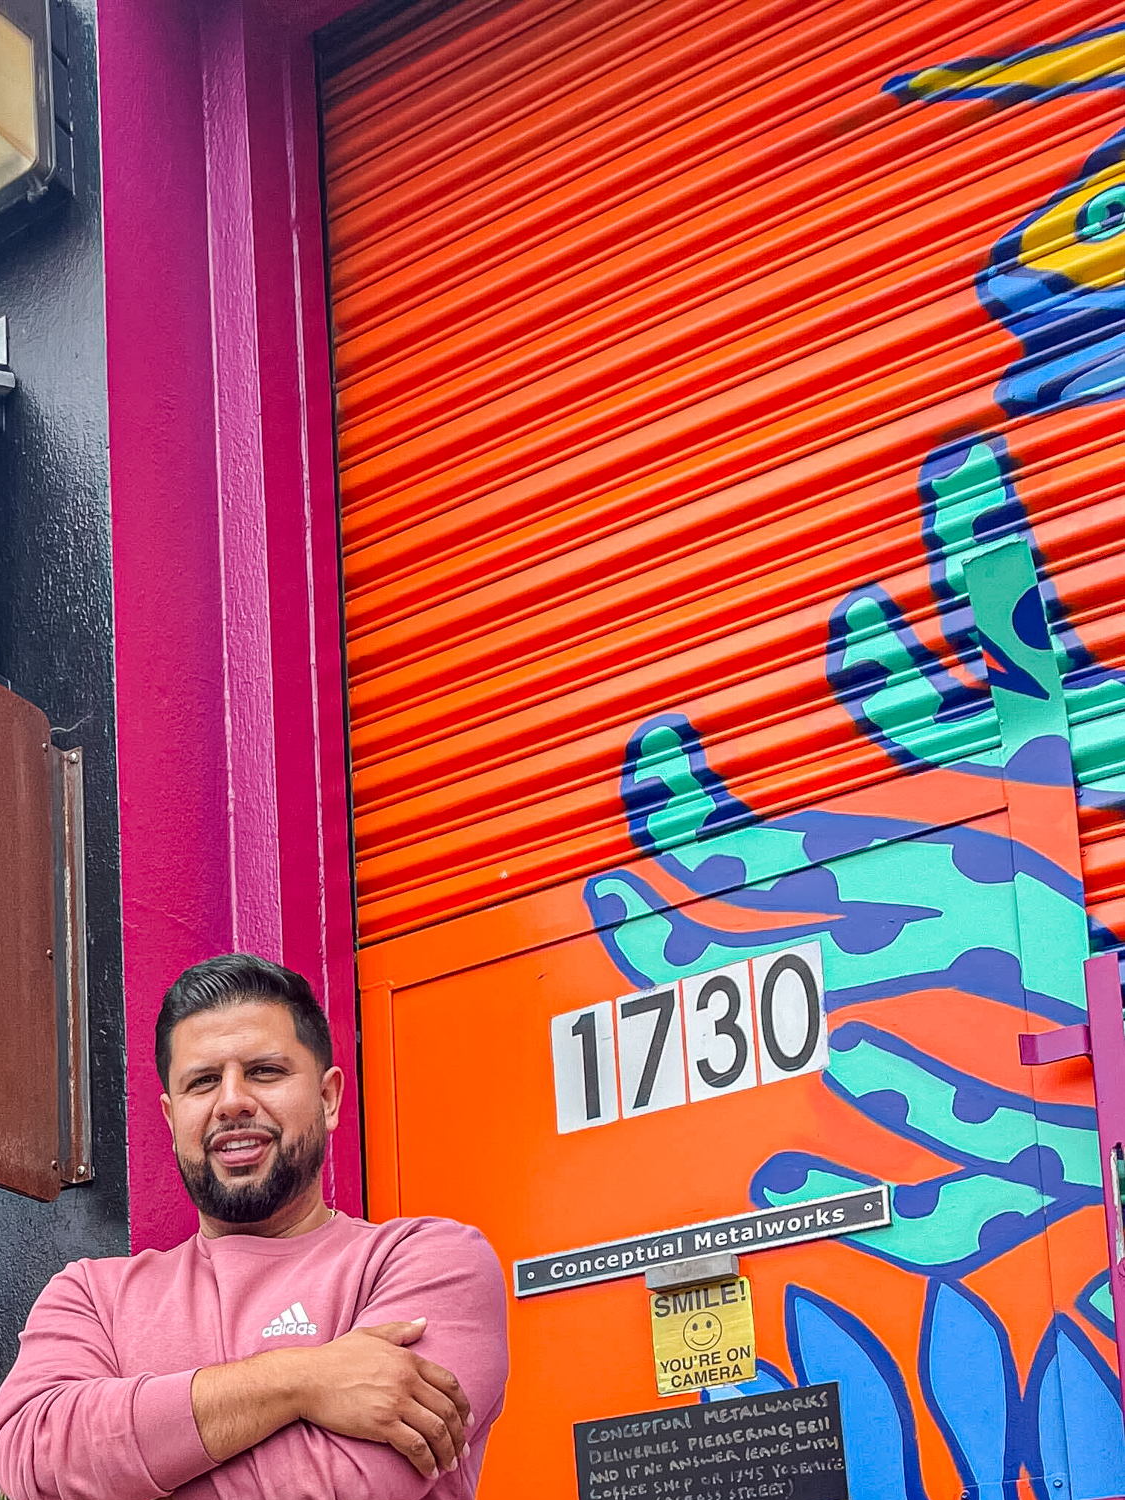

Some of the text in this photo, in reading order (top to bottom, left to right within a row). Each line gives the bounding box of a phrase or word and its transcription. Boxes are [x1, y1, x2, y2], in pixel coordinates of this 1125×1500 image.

[571, 953, 820, 1121] 1730
[549, 1205, 846, 1280] Conceptual Metalworks
[653, 1281, 748, 1318] SMILE!
[262, 1320, 317, 1338] adidas
[660, 1345, 752, 1374] YOU'RE ON
[670, 1364, 743, 1388] CAMERA
[703, 1391, 828, 1424] METALWORKS
[589, 1469, 619, 1485] AND
[625, 1464, 641, 1480] IF
[669, 1449, 741, 1472] ANSWER
[796, 1436, 840, 1451] WITH
[701, 1473, 724, 1485] OR
